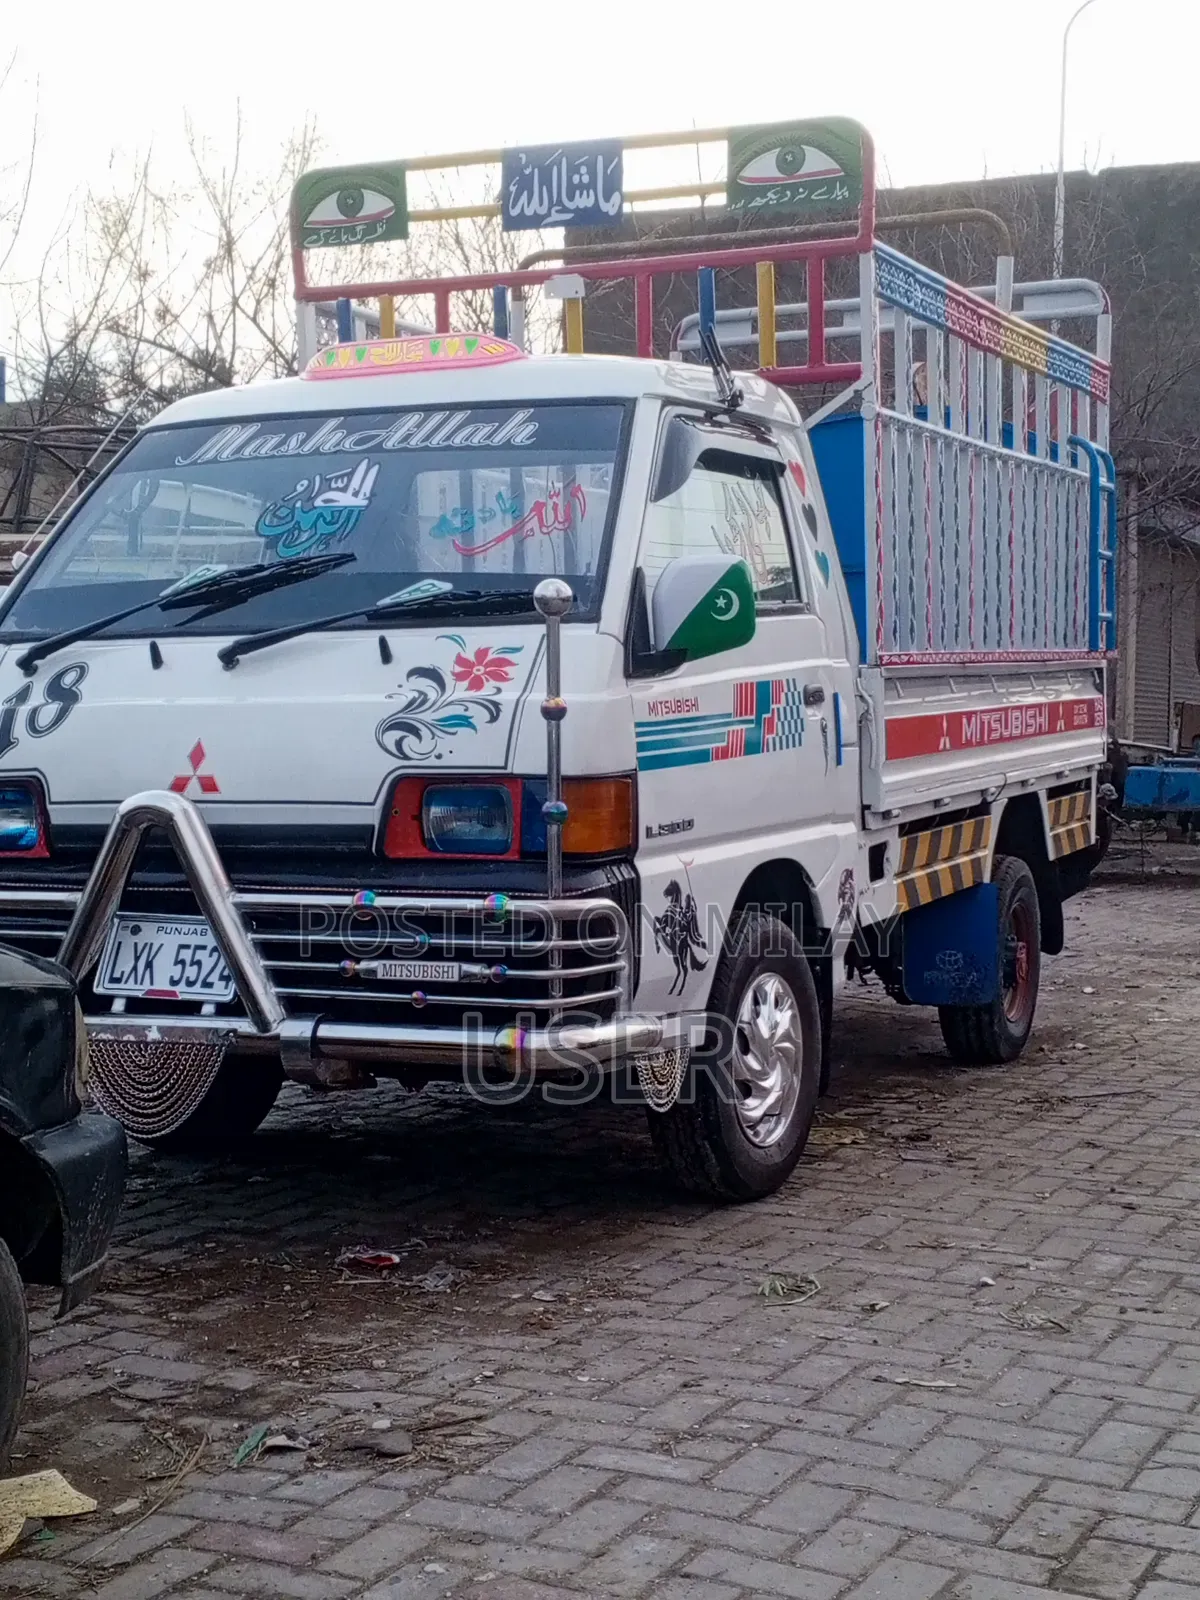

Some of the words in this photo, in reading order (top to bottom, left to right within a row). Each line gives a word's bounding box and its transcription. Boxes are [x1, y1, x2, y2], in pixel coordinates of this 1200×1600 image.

[647, 696, 700, 717] MITSUBISHI
[961, 703, 1049, 746] MITSUBISHI
[156, 925, 208, 937] PUNJAB
[107, 941, 164, 986] LXK
[381, 963, 455, 980] MITSUBISHI
